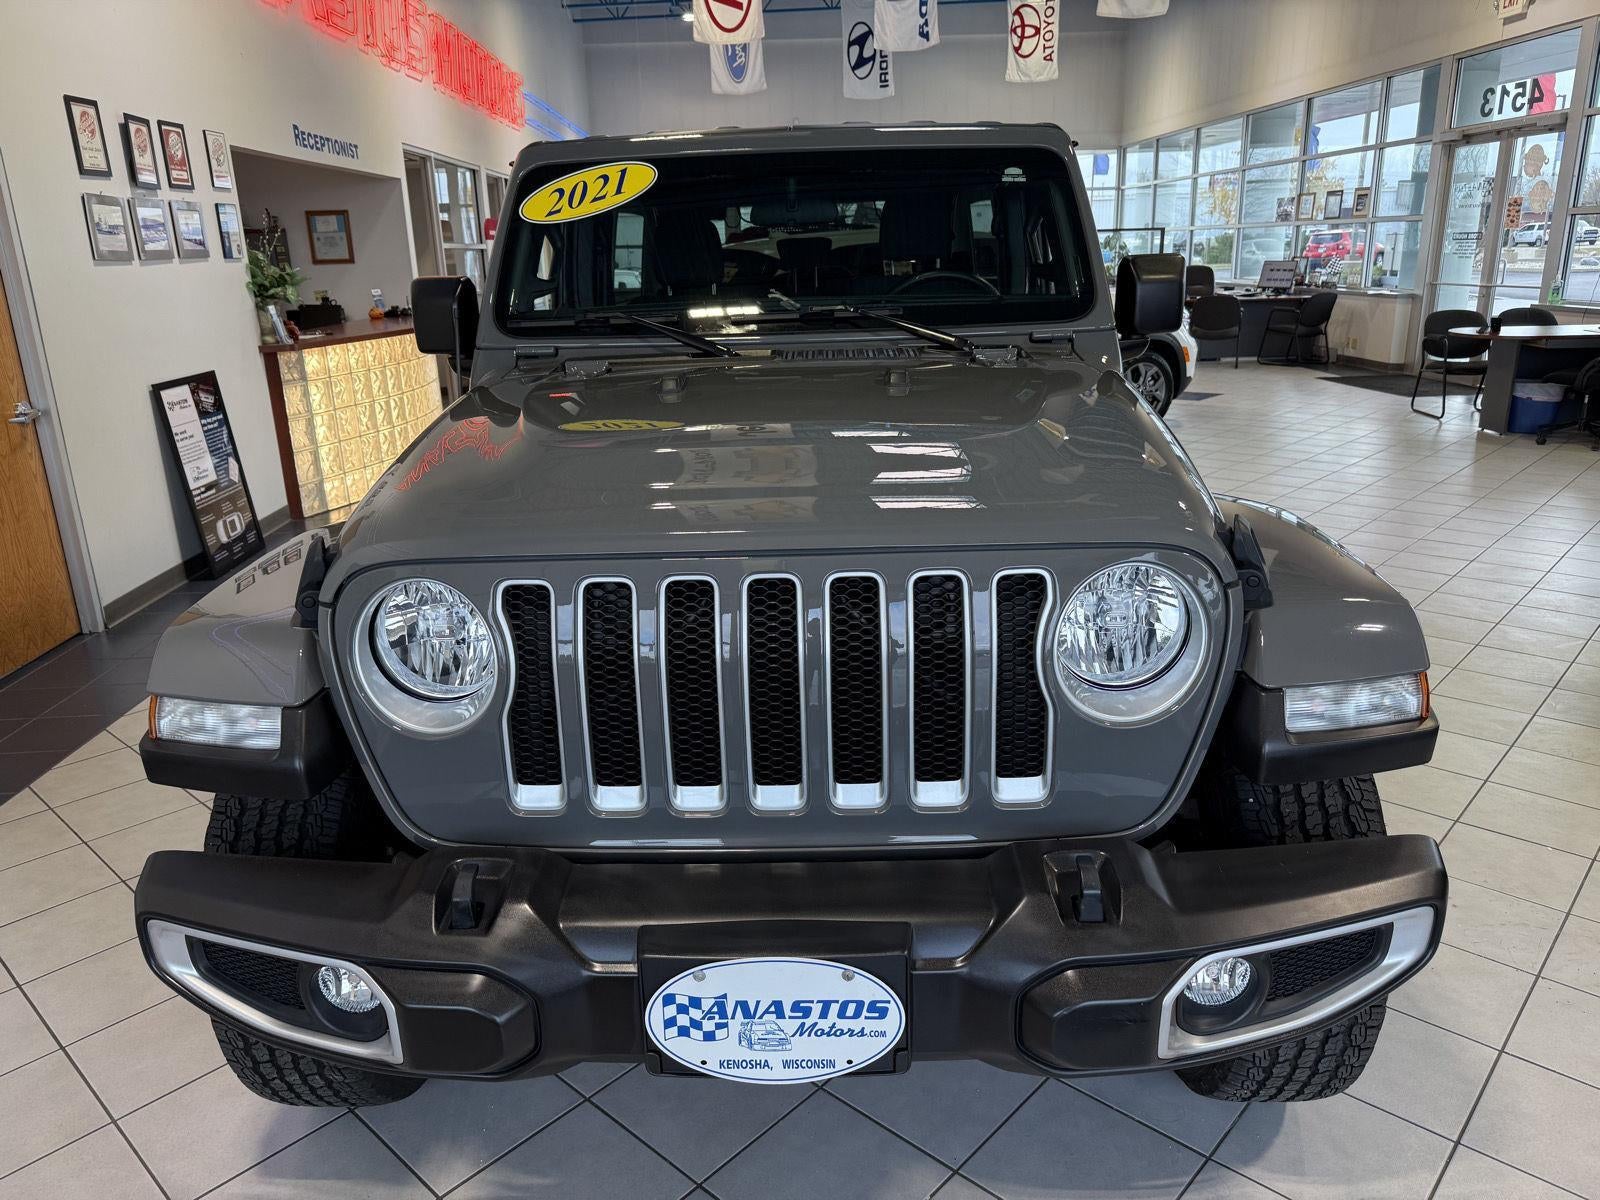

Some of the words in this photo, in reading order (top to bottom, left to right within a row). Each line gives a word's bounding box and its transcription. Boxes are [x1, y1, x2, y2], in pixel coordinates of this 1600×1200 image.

[292, 124, 359, 160] RECEPTIONIST
[545, 167, 629, 218] 2021
[700, 999, 891, 1021] ANASTOS
[719, 1058, 774, 1071] KENOSHA,
[782, 1058, 836, 1070] WISCONSIN
